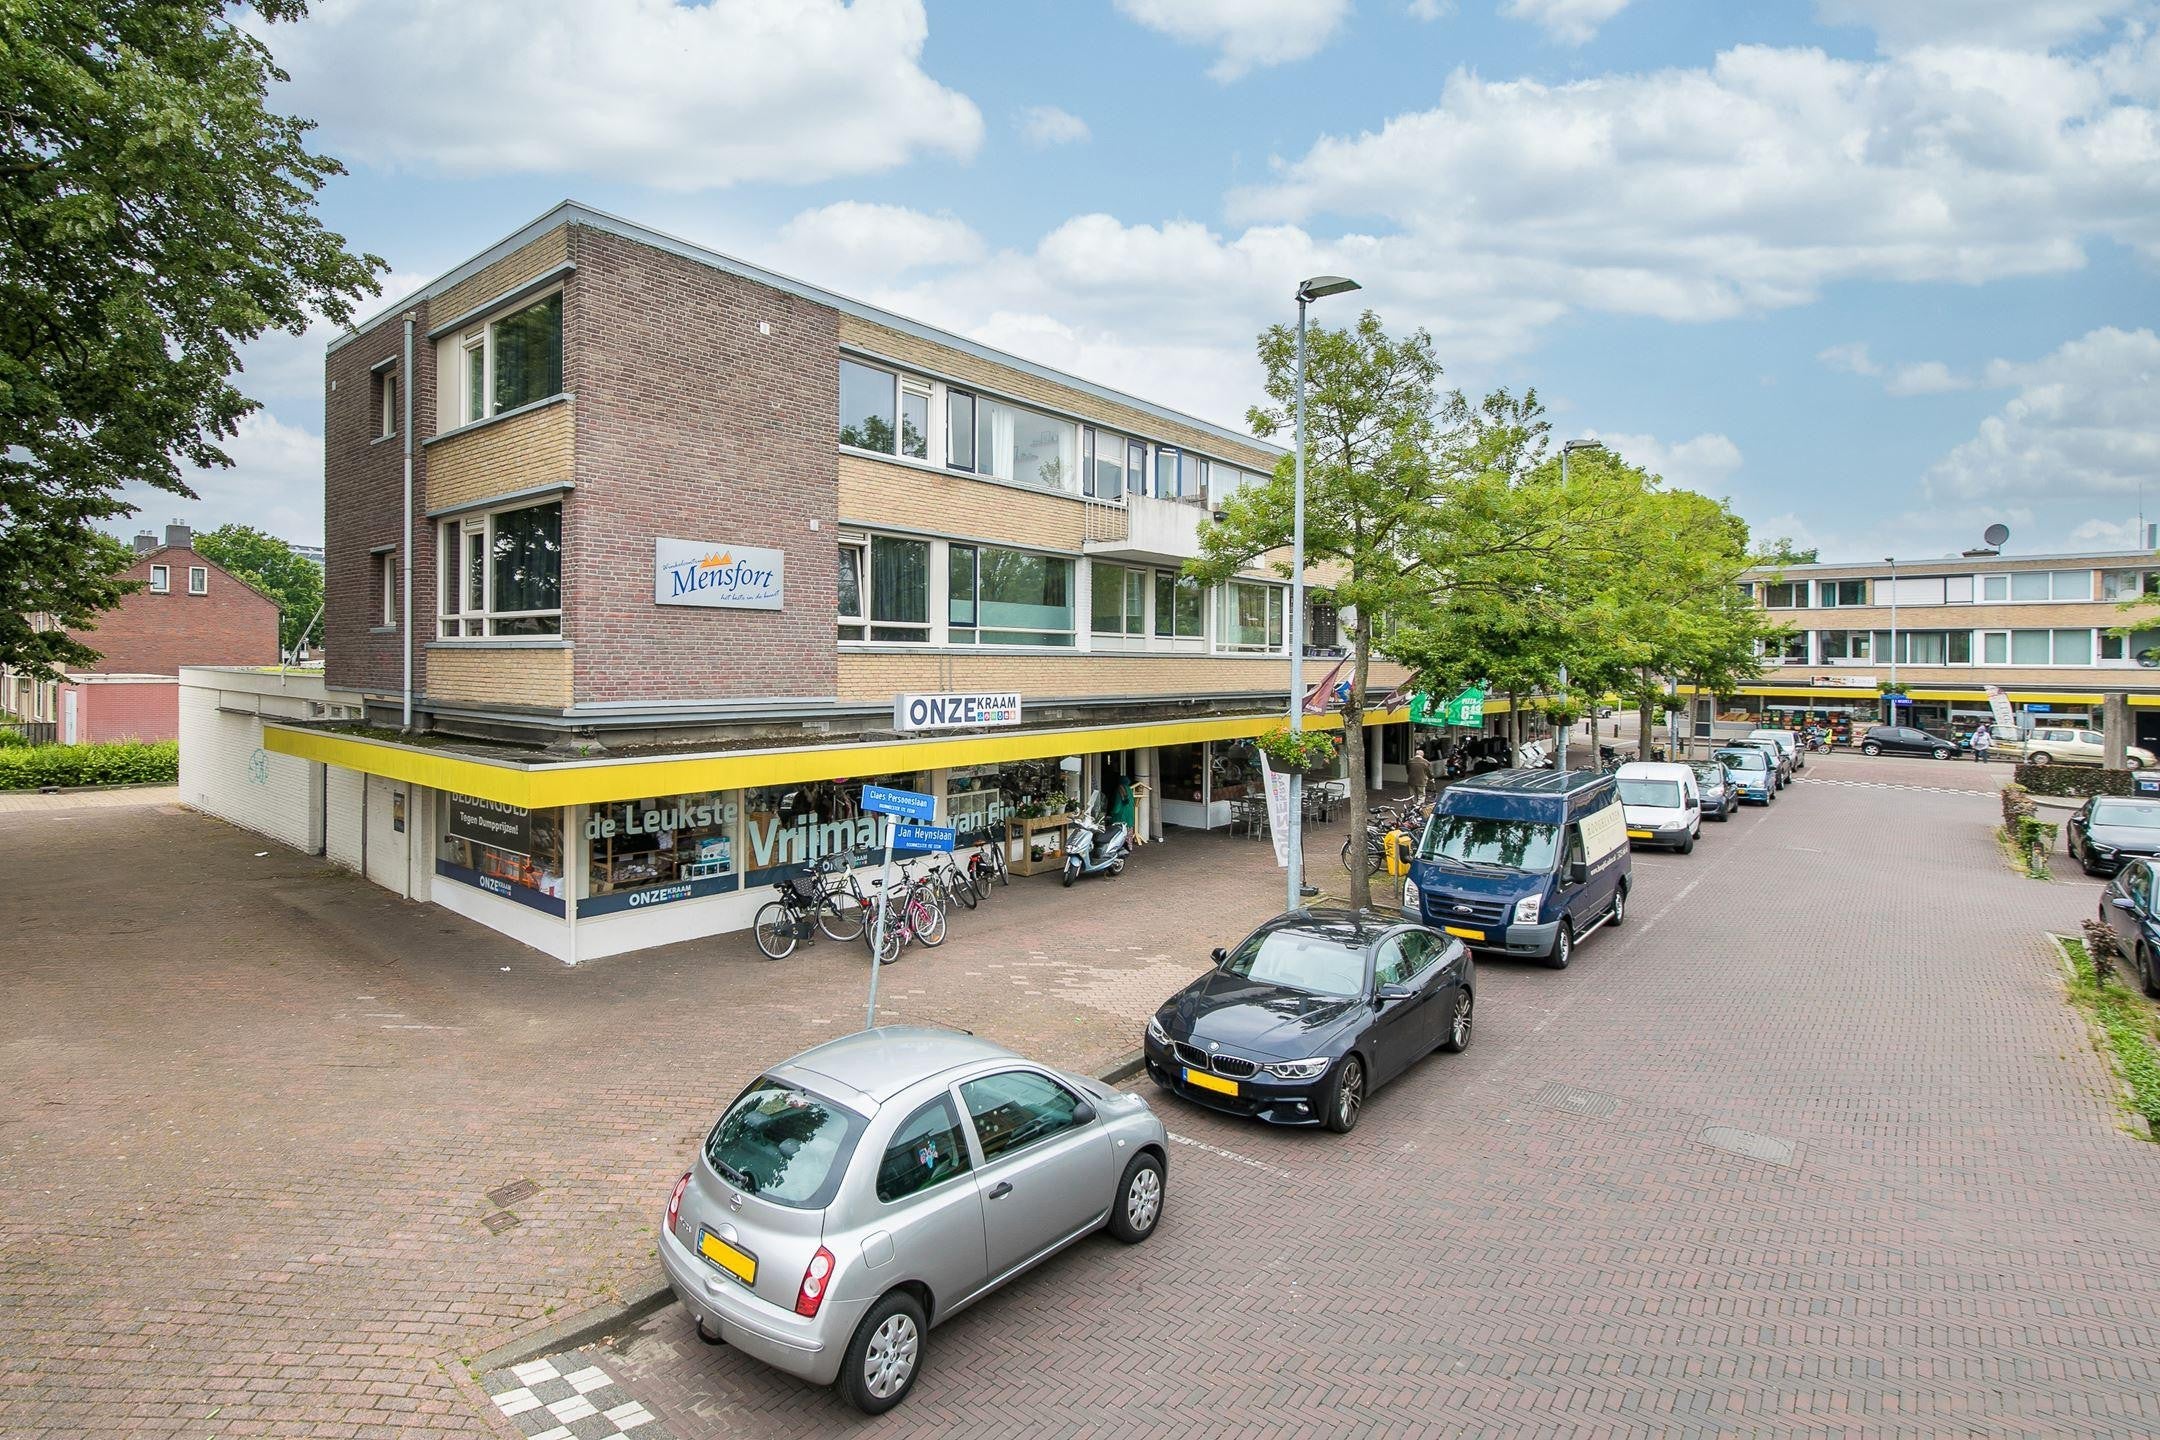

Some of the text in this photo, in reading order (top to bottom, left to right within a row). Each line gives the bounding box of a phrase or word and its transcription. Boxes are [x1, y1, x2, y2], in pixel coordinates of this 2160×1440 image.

[671, 560, 773, 597] Mensfort
[910, 697, 1016, 726] ONZE KRAAM
[869, 790, 928, 808] Claes Persoonslaan
[460, 811, 519, 835] Tegen Dumpprijzen!
[585, 799, 737, 840] de Leukste
[898, 826, 952, 842] Jan Heynslaan
[480, 875, 499, 892] ONZE
[629, 885, 692, 907] ONZE KRAAM
